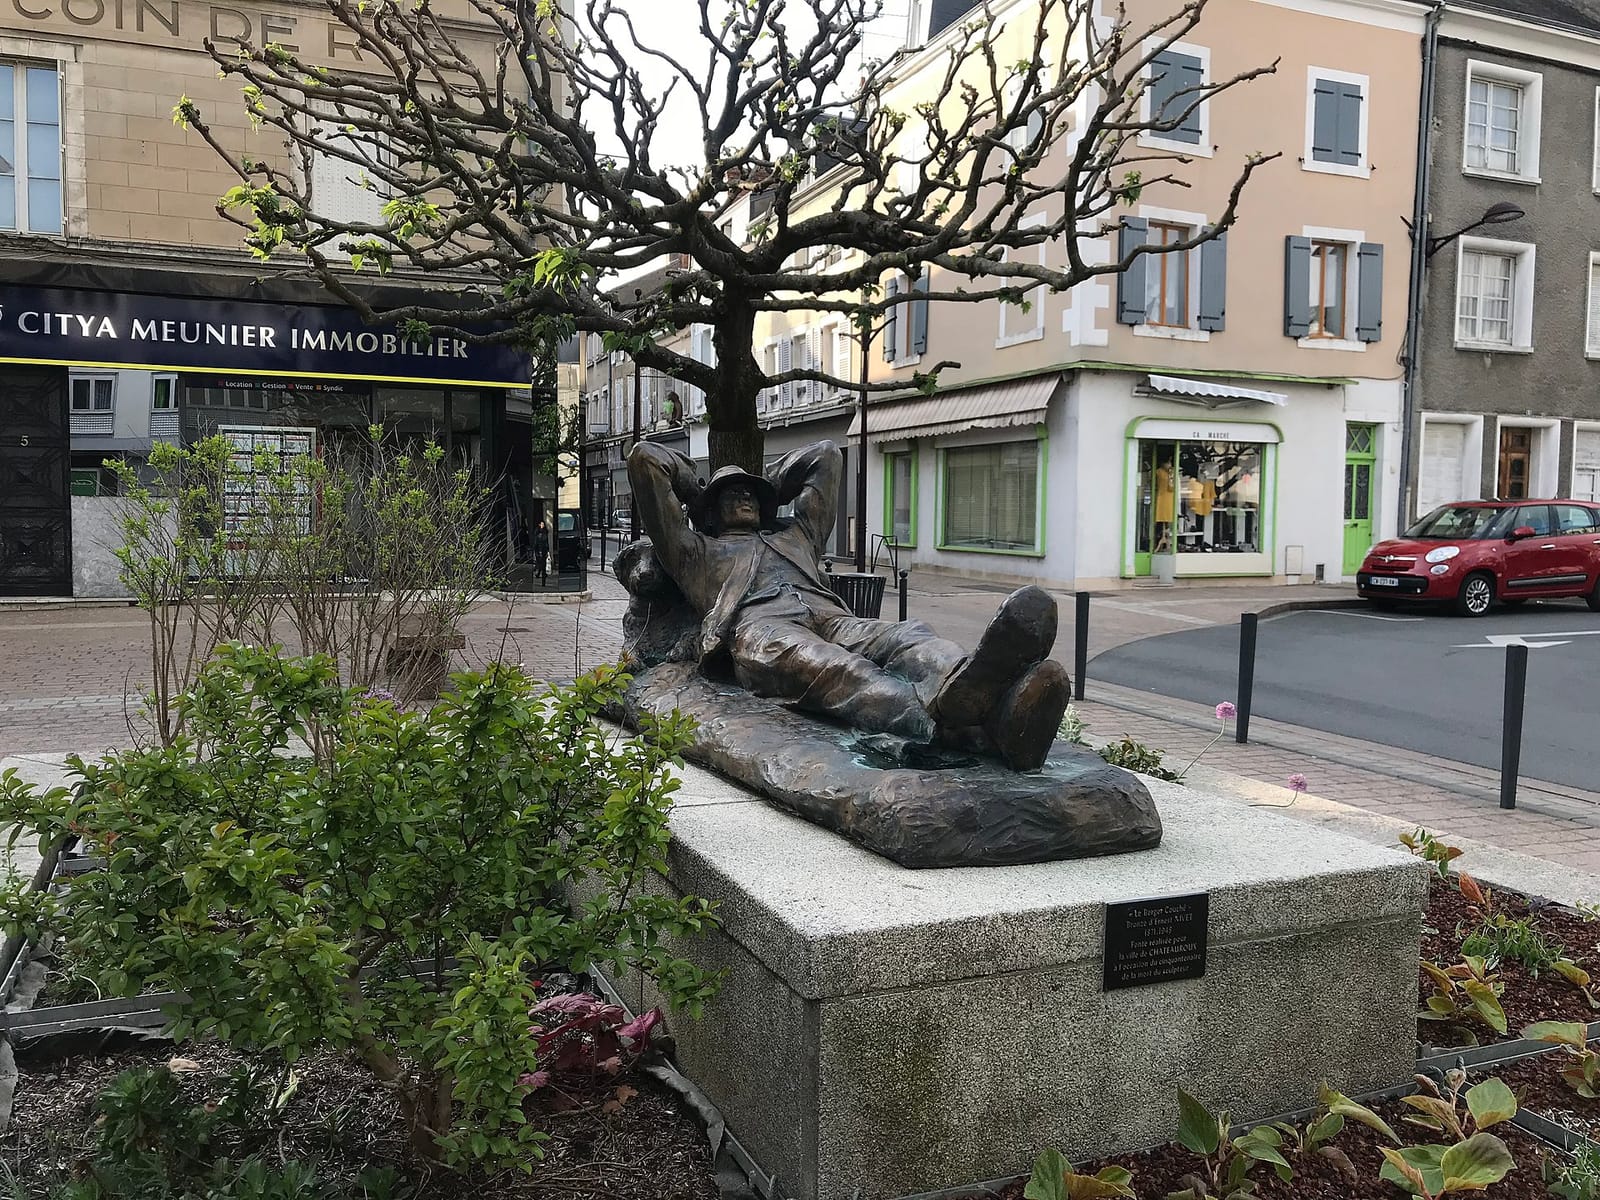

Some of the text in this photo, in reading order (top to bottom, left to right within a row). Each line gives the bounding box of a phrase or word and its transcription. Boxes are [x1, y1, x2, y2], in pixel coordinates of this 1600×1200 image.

[209, 6, 299, 53] DE
[18, 311, 118, 339] CITYA
[130, 318, 276, 349] MEUNIER
[291, 327, 468, 359] IMMOBILIER
[225, 380, 253, 388] Location
[323, 384, 343, 392] Syndic
[1207, 431, 1229, 439] MARCHE
[20, 435, 29, 447] 5
[1134, 909, 1142, 918] Le
[1126, 920, 1148, 929] Bronze
[1131, 940, 1148, 949] Fonte
[1172, 936, 1187, 945] pour
[1140, 949, 1147, 958] de
[1150, 958, 1158, 967] du
[1138, 969, 1152, 978] mort
